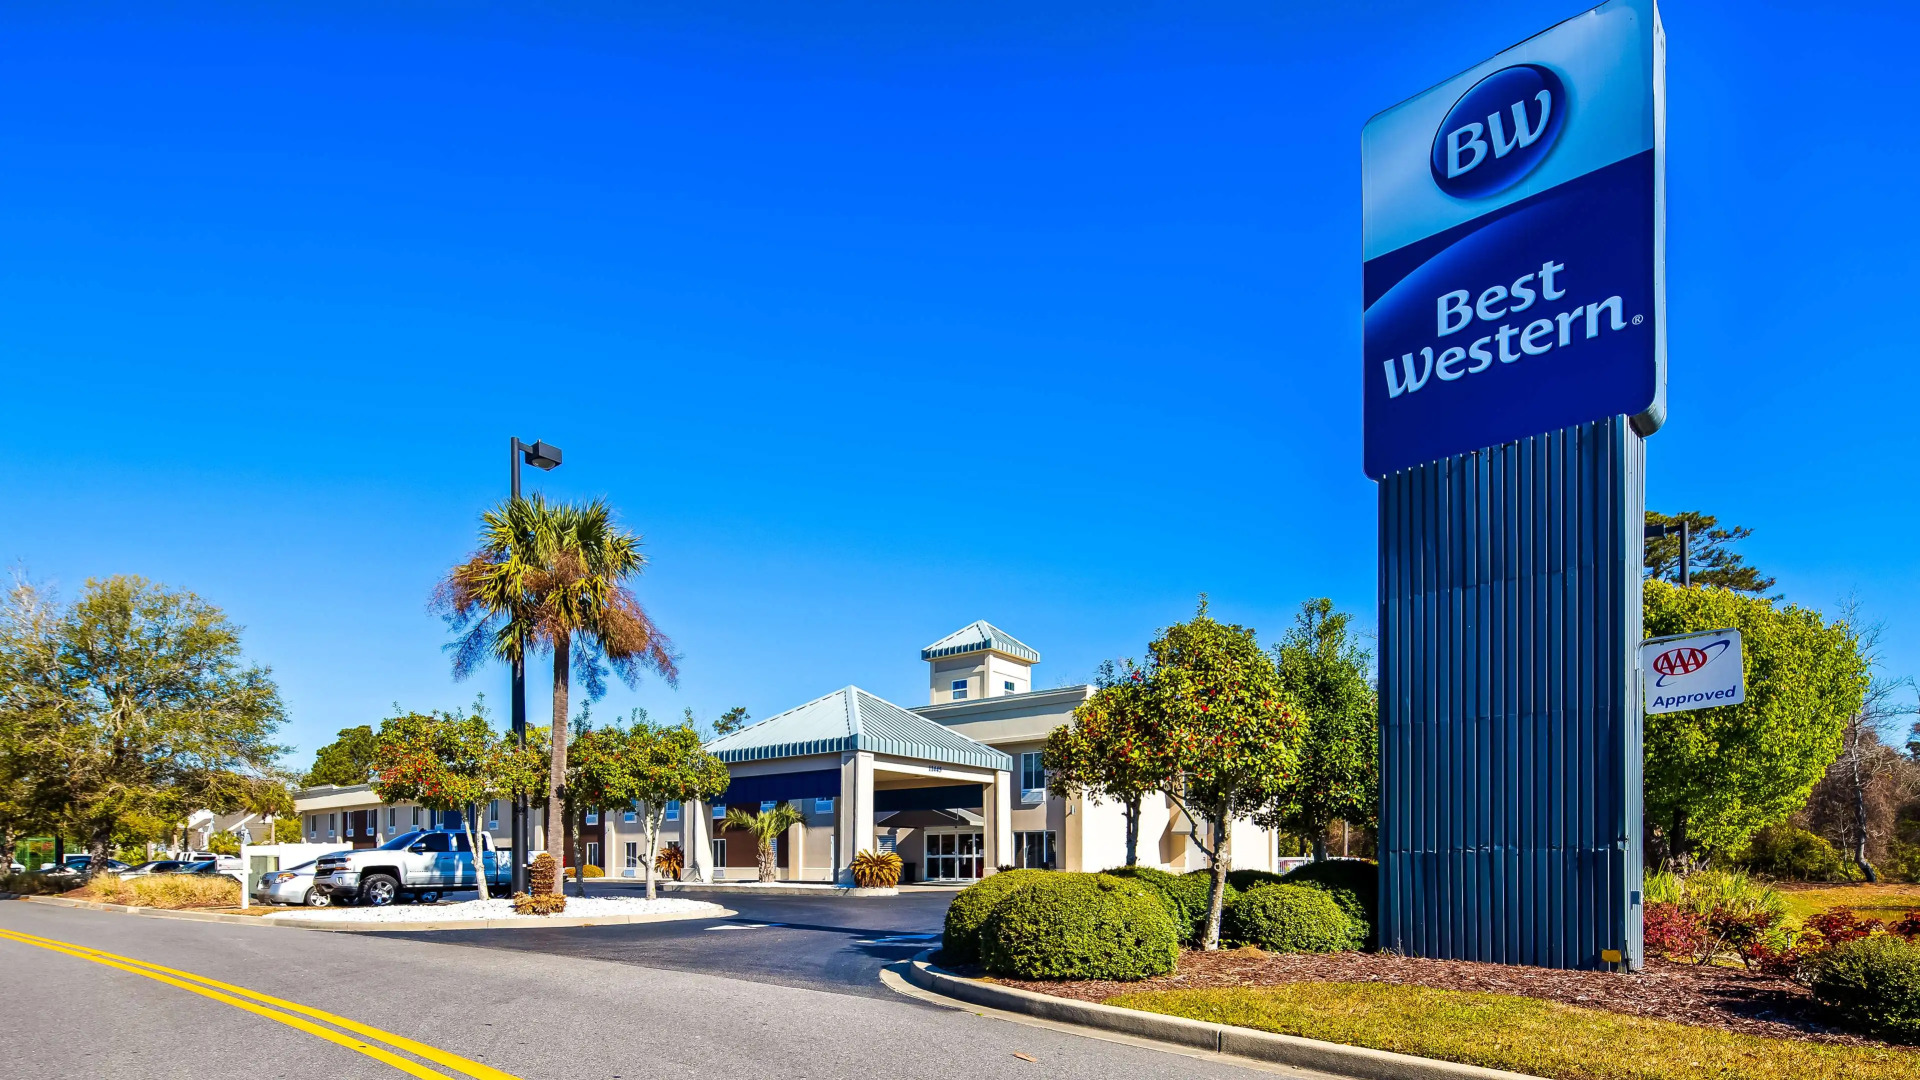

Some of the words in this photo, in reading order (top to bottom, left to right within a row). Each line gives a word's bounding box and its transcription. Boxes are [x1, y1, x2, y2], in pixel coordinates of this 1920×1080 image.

[1447, 89, 1551, 179] BW
[1437, 260, 1566, 338] Best
[1658, 648, 1703, 675] AAA
[1652, 685, 1736, 708] Approved
